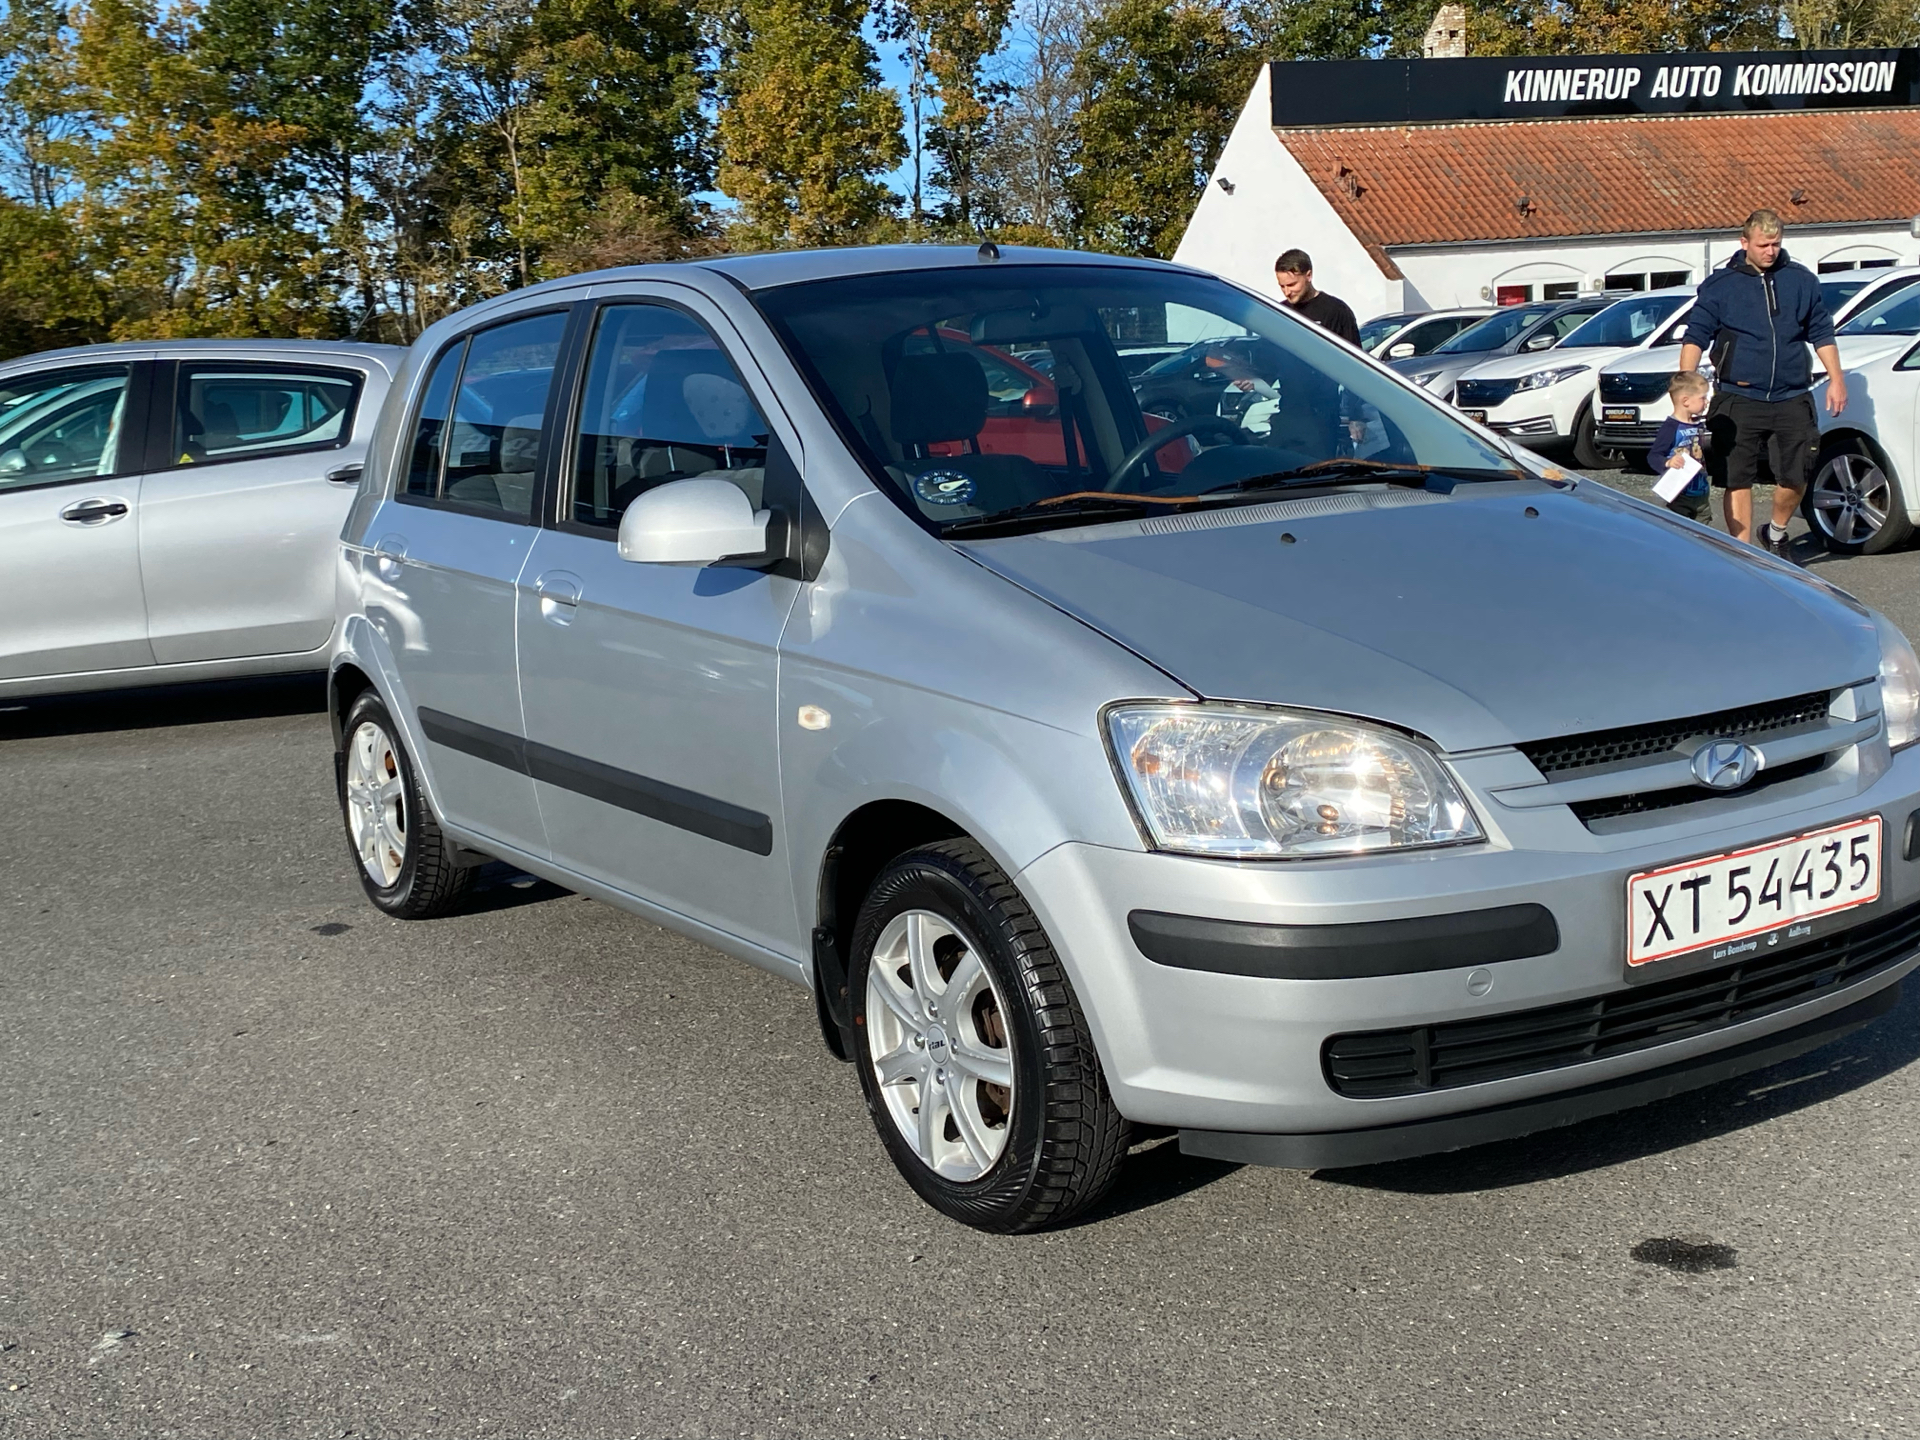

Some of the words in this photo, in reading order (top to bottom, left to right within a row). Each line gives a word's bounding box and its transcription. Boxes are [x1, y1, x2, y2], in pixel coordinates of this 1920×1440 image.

[1503, 67, 1641, 102] KINNERUP
[1651, 65, 1722, 98] AUTO
[1733, 61, 1897, 95] KOMMISSION
[1643, 875, 1711, 947] XT
[1728, 834, 1870, 926] 54435
